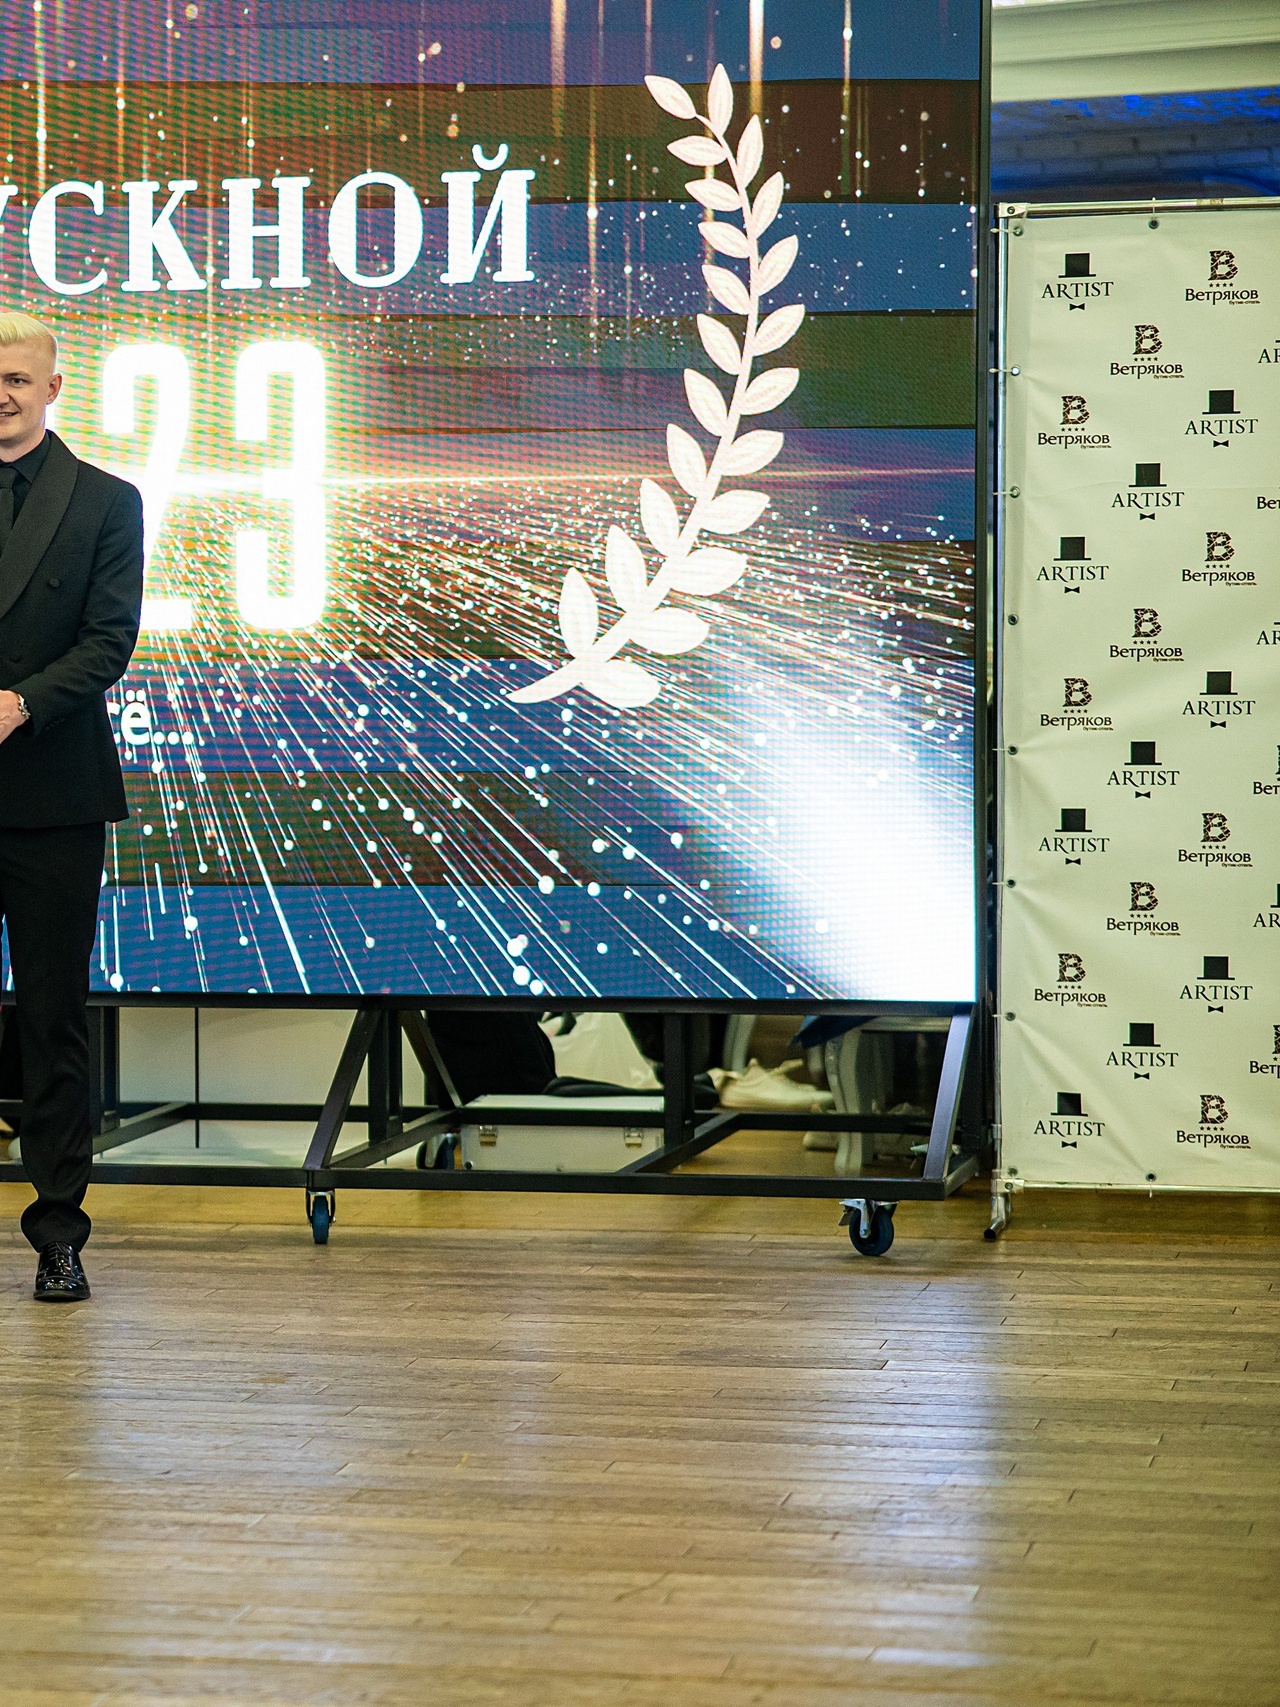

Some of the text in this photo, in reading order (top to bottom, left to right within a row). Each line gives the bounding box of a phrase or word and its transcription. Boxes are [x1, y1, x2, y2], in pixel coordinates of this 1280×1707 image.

[1041, 281, 1115, 300] ARTIST
[1185, 288, 1260, 305] Ветряков
[1110, 362, 1184, 380] Ветряков
[1184, 419, 1260, 436] ARTIST
[1037, 432, 1111, 449] Ветряков
[1111, 492, 1186, 509] ARTIST
[1036, 565, 1110, 582] ARTIST
[1181, 568, 1256, 586] Ветряков
[1109, 644, 1183, 662] Ветряков
[1182, 700, 1257, 718] ARTIST
[1040, 714, 1113, 731] Ветряков
[1106, 770, 1180, 788] ARTIST
[1037, 837, 1111, 854] ARTIST
[1178, 849, 1252, 867] Ветряков
[1106, 917, 1180, 935] Ветряков
[1034, 988, 1107, 1006] Ветряков
[1179, 985, 1255, 1002] ARTIST
[1105, 1051, 1180, 1069] ARTIST
[1032, 1119, 1106, 1138] ARTIST
[1176, 1130, 1250, 1148] Ветряков
